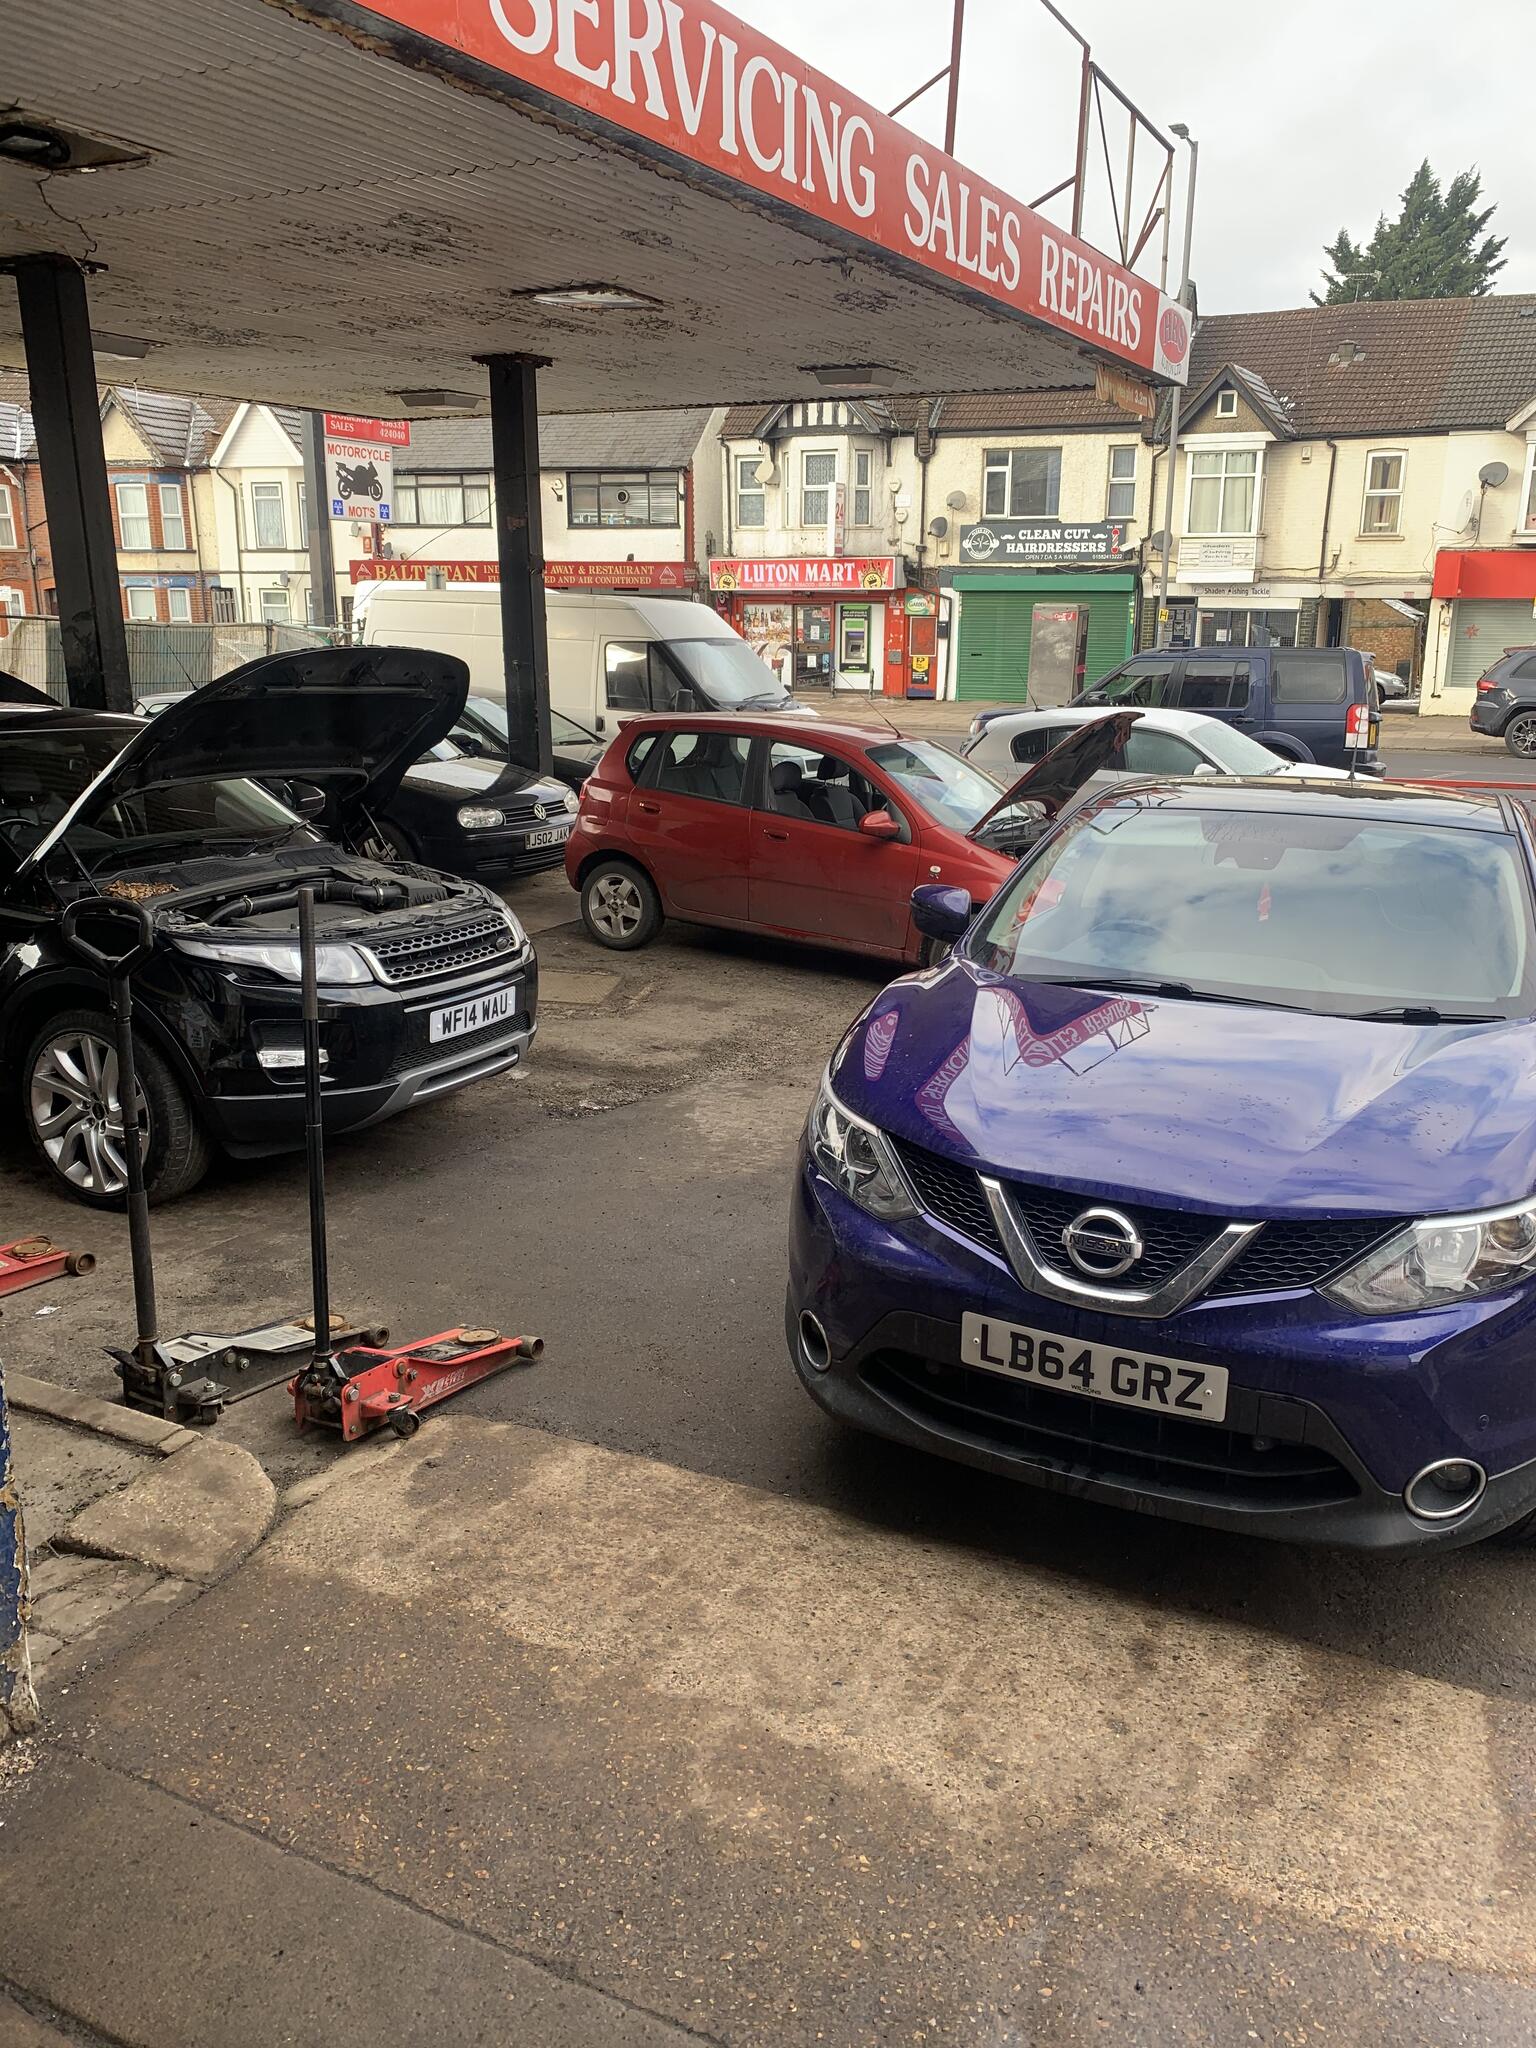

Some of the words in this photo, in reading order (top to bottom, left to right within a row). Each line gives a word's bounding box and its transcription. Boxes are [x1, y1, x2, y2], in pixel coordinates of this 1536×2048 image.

[904, 154, 1022, 292] SALES
[1039, 234, 1143, 351] REPAIRS
[330, 421, 354, 433] SALES
[327, 443, 391, 462] MOTORCYCLE
[348, 505, 376, 518] MOT'S
[1018, 529, 1062, 540] CLEAN
[1064, 528, 1091, 540] CUT
[1005, 542, 1107, 554] HAIRDRESSERS
[551, 565, 575, 575] AWAY
[578, 565, 586, 575] &
[588, 566, 655, 575] RESTAURANT
[743, 563, 800, 583] LUTON
[805, 562, 856, 582] MART
[556, 576, 576, 585] AND
[578, 576, 593, 585] AIR
[595, 576, 652, 585] CONDITIONED
[1204, 587, 1226, 595] Shaden
[1251, 587, 1270, 595] Tackle
[531, 832, 553, 847] JS02
[554, 828, 569, 842] JAK
[442, 1004, 478, 1035] WF14
[482, 992, 508, 1022] WAU
[1068, 1234, 1132, 1255] NISSAN
[980, 1324, 1095, 1388] LB64
[1110, 1356, 1206, 1411] GRZ
